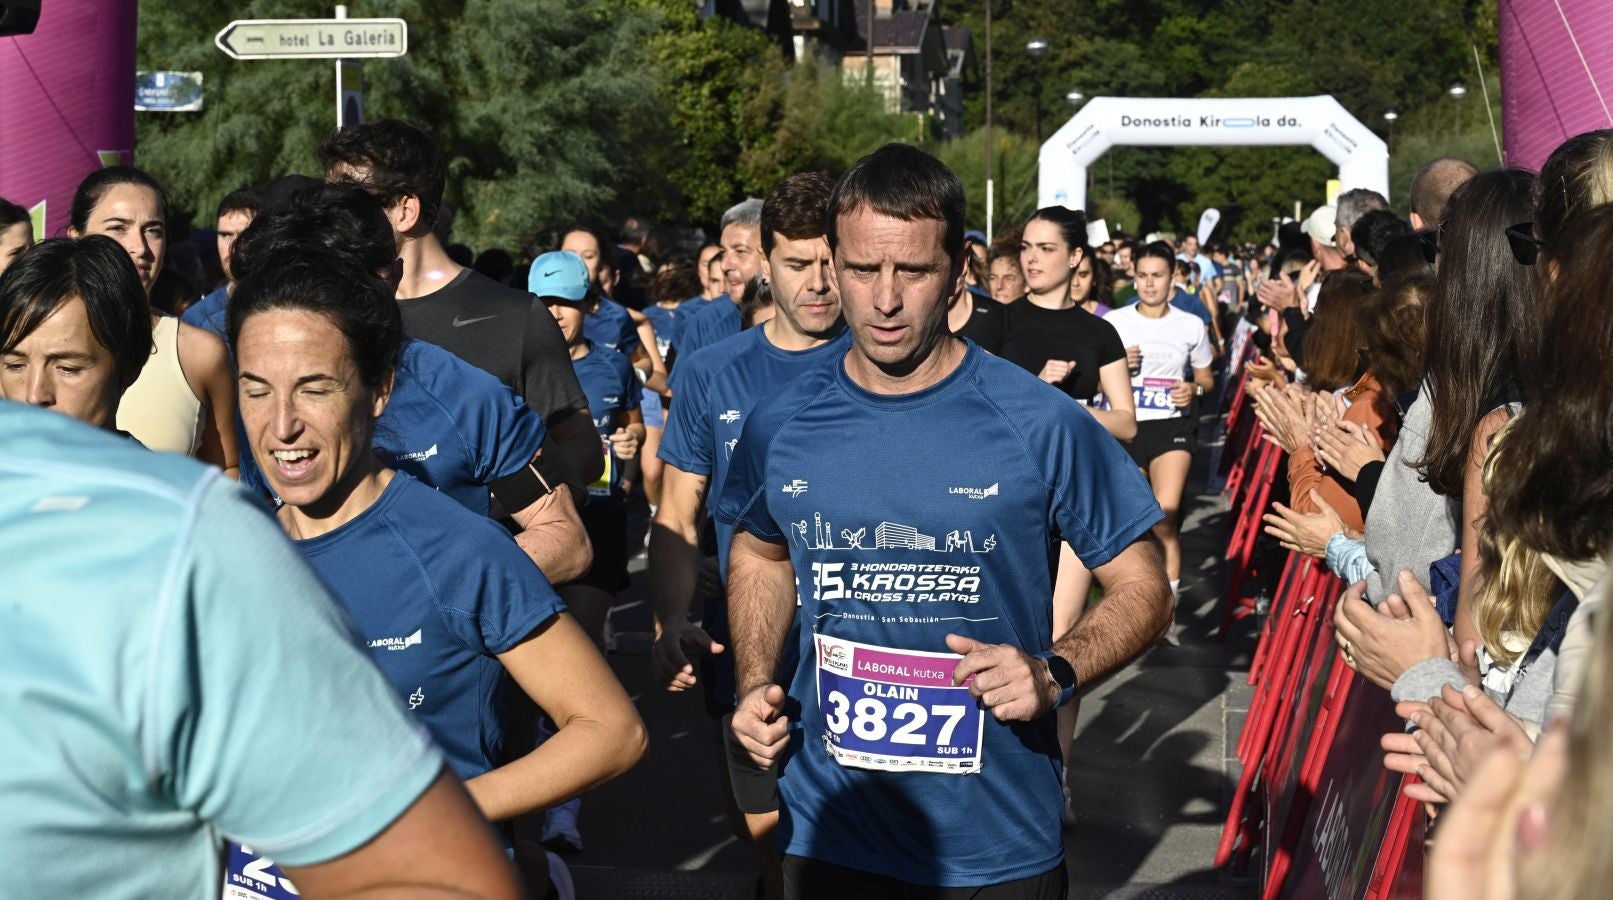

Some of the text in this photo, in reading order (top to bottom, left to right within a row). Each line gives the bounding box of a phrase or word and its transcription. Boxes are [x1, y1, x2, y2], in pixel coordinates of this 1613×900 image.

[279, 30, 396, 47] hotel La Galeria
[1121, 114, 1192, 128] Donostia
[1277, 114, 1302, 128] da.
[949, 486, 983, 495] LABORAL
[851, 563, 981, 575] 3 HONDARTZETAKO
[852, 573, 981, 593] KROSSA
[854, 591, 981, 604] CROSS 3 PLAYAS
[842, 612, 939, 624] Donostia San Sebastián
[857, 660, 911, 677] LABORAL
[913, 667, 945, 680] kutxa
[863, 682, 919, 701] OLAIN
[826, 689, 966, 747] 3827
[937, 746, 973, 755] SUB 1h
[232, 873, 268, 892] SUB 1h
